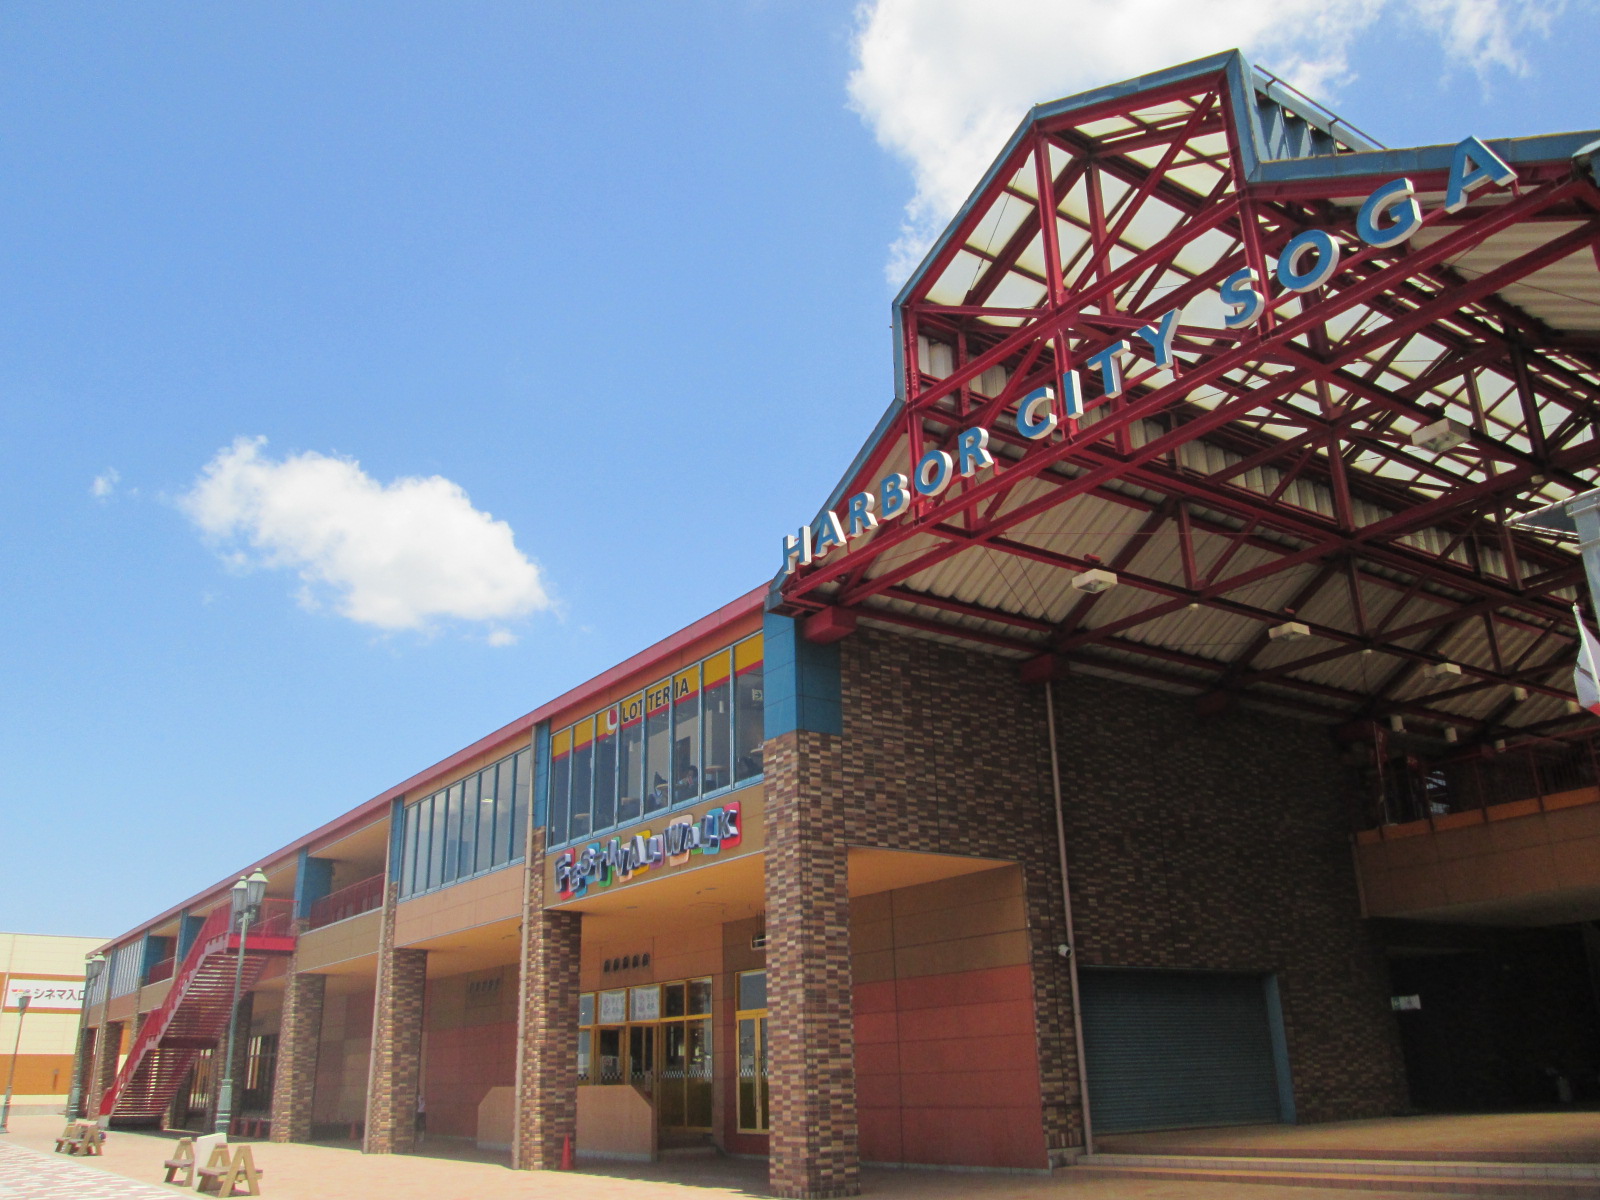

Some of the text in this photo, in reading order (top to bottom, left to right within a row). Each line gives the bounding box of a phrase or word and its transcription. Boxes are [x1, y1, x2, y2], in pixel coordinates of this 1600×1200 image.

[783, 135, 1519, 574] HARBOR CITY SOGA
[622, 678, 690, 723] LOTTERIA
